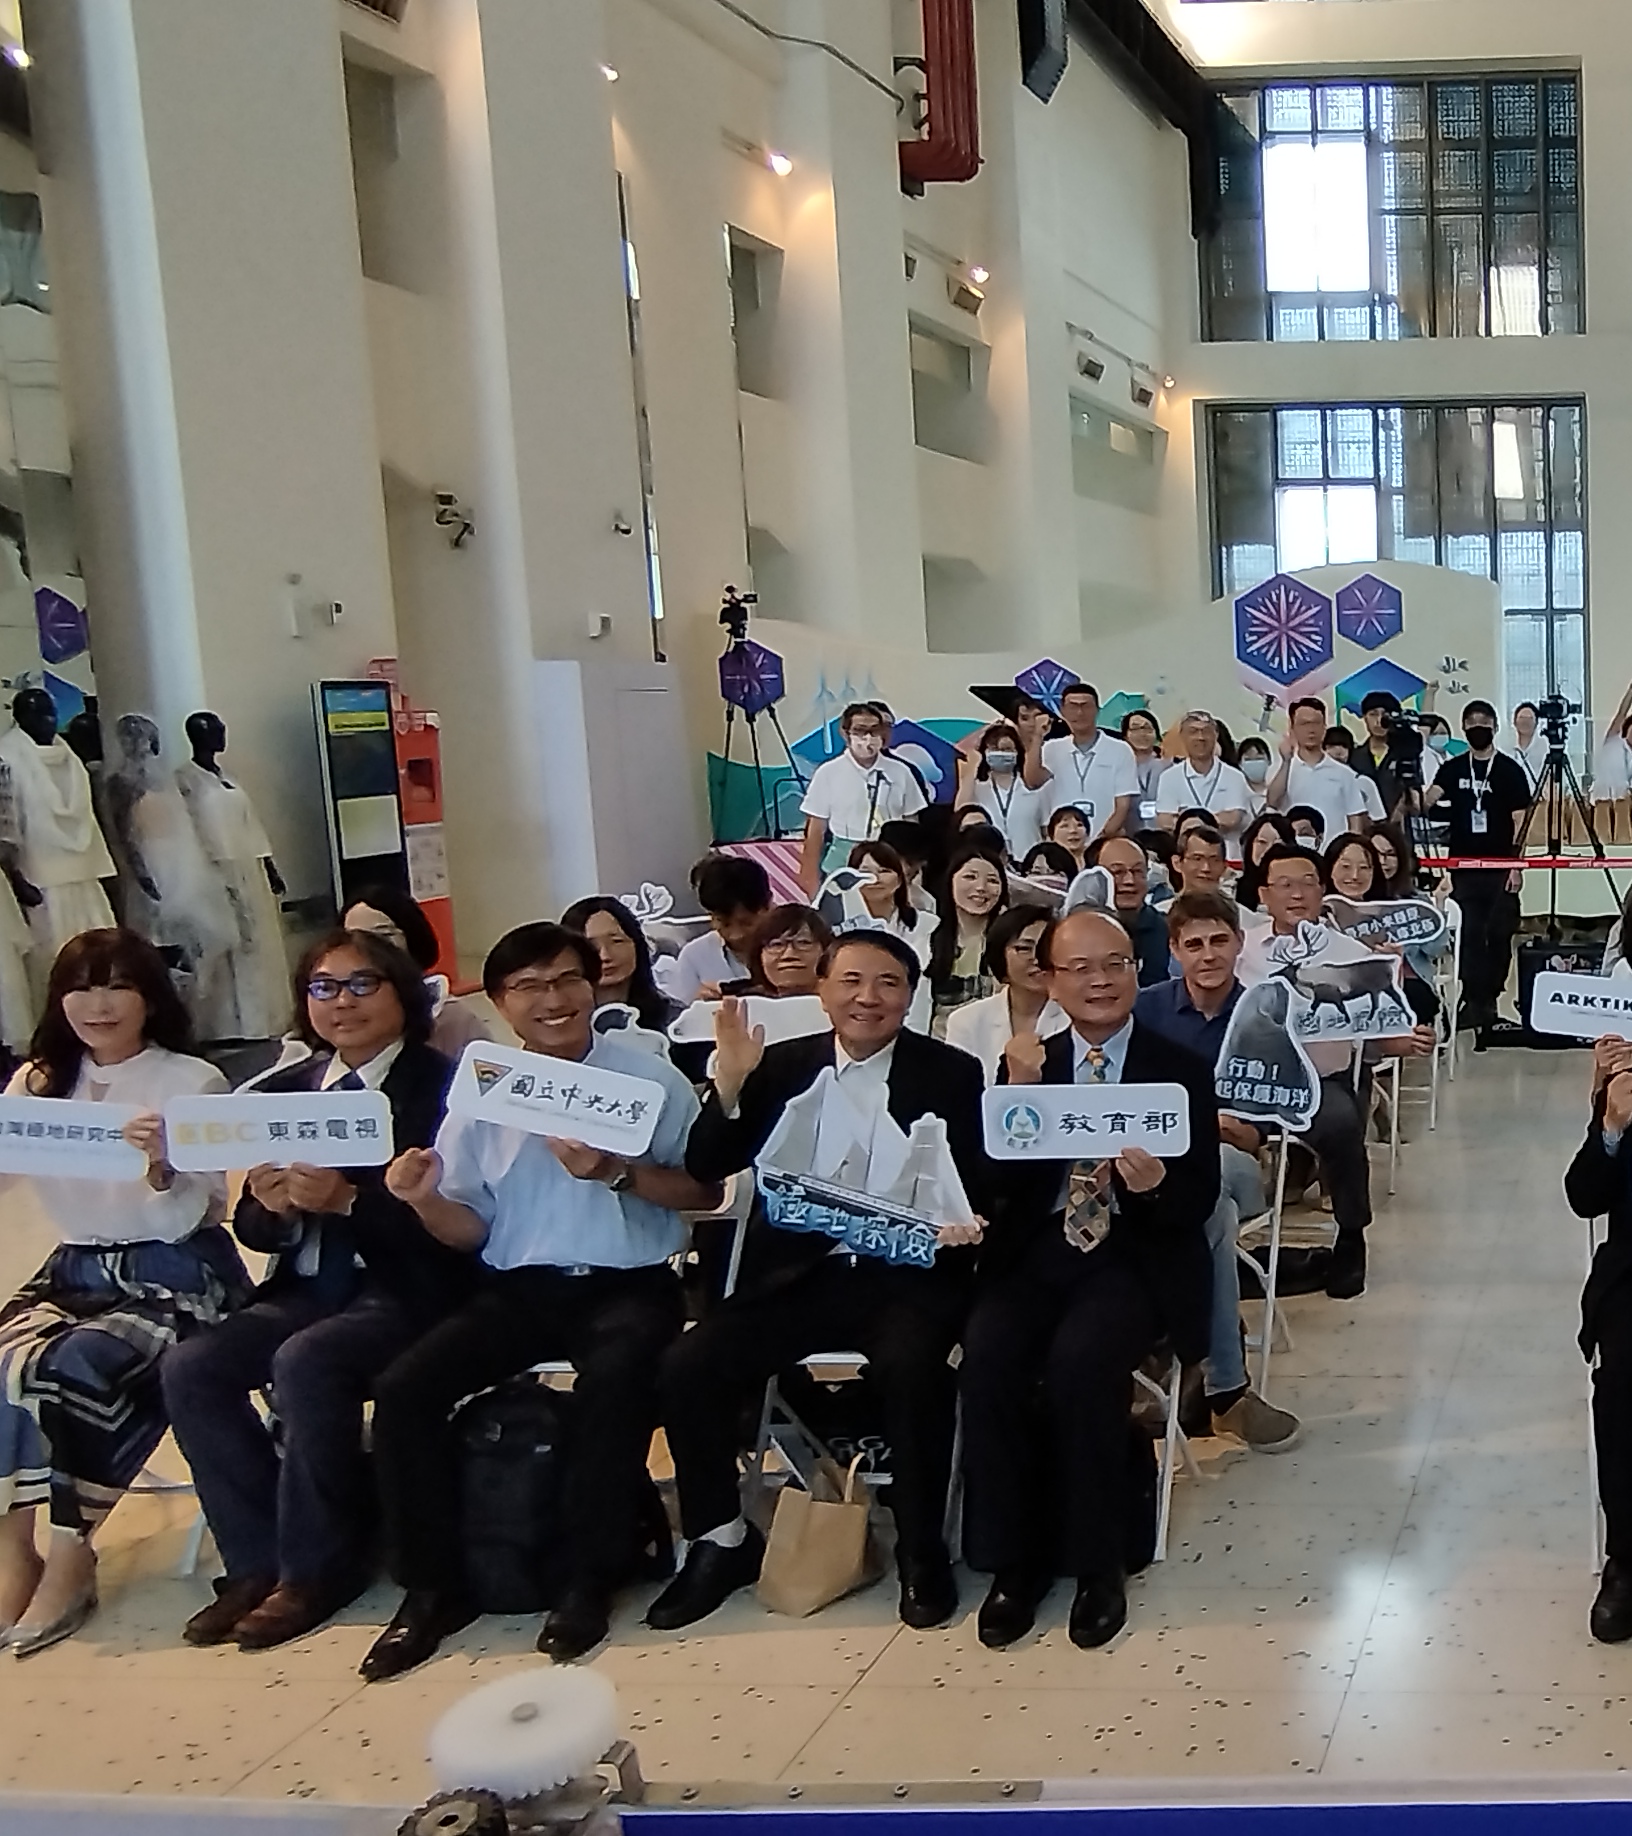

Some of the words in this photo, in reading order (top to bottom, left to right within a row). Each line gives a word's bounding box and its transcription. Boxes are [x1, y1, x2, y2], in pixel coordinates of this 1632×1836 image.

[510, 1074, 649, 1125] 國立中央大學
[0, 1119, 124, 1143] 灣極地研究中
[267, 1118, 379, 1141] 東森電視
[1058, 1109, 1179, 1135] 教育部
[773, 1184, 932, 1262] 極地探險
